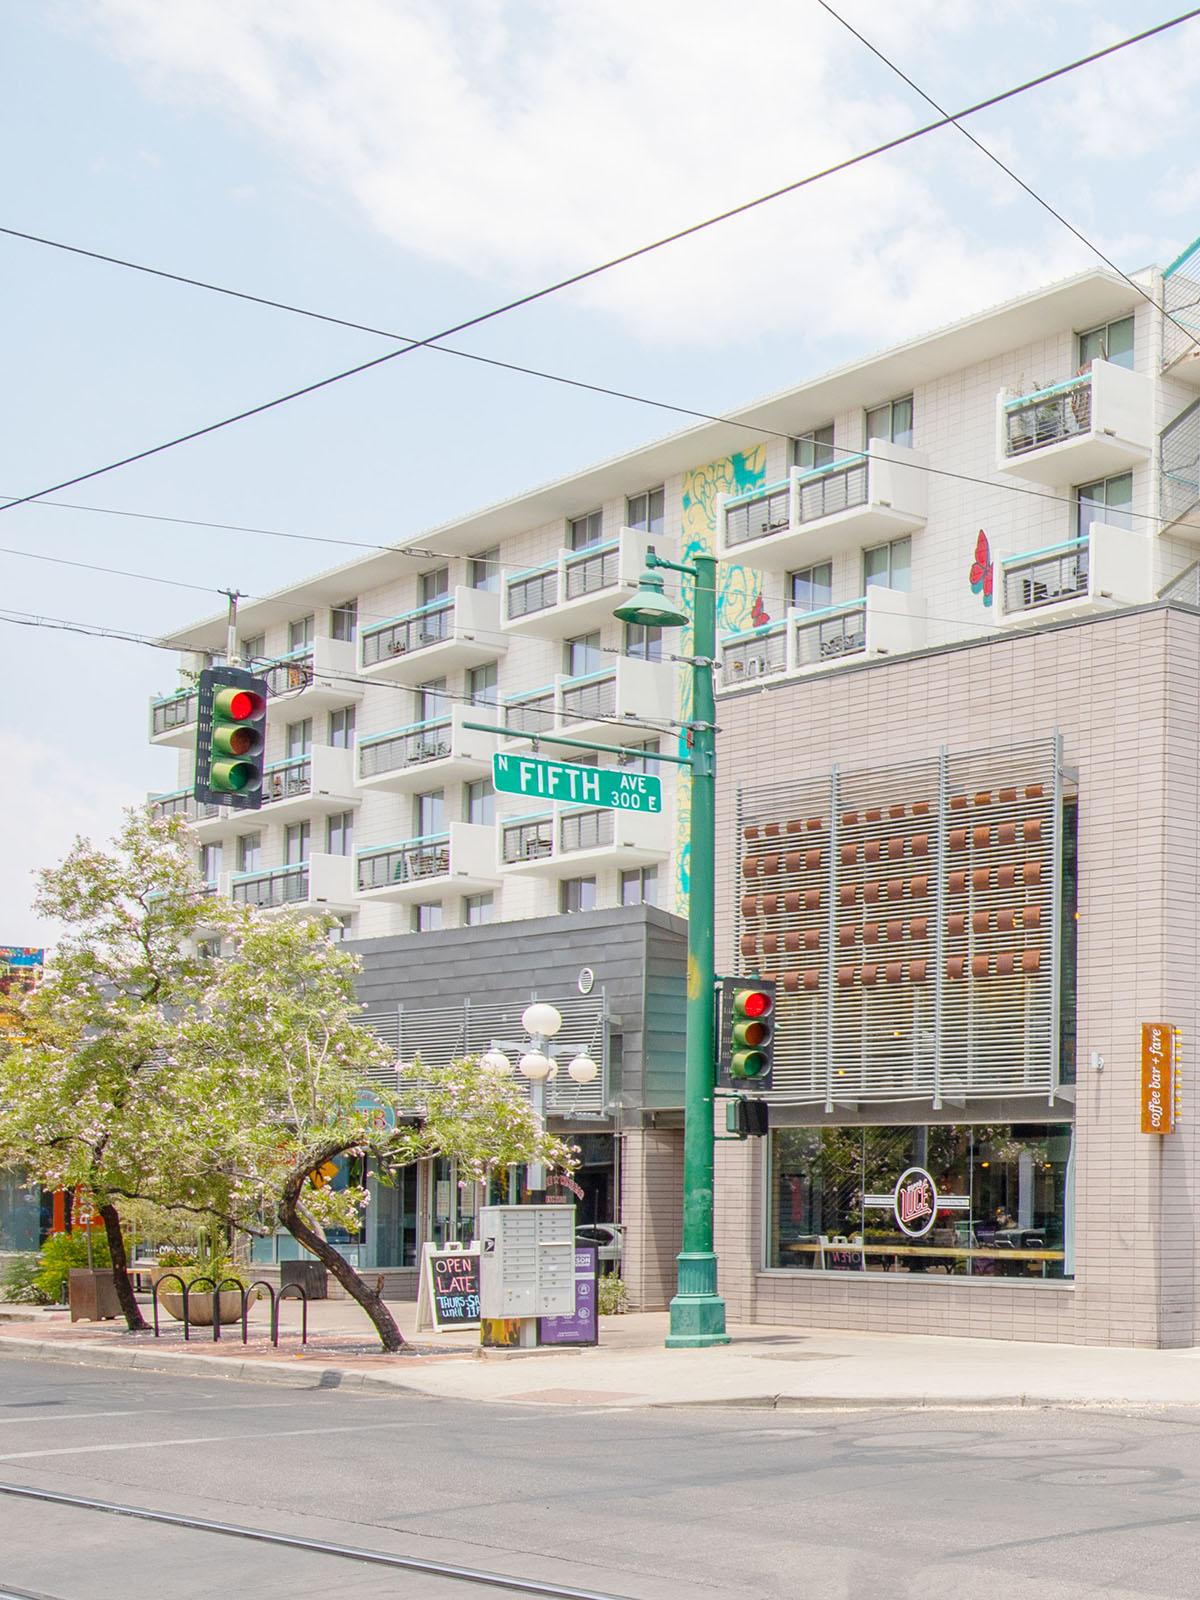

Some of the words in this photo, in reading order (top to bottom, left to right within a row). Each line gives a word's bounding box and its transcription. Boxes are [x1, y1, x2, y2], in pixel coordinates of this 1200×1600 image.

[498, 756, 509, 772] N
[519, 762, 600, 801] FIFTH
[620, 775, 647, 794] AVE
[611, 791, 640, 809] 300
[648, 796, 657, 811] E
[1148, 1028, 1164, 1057] fare
[1148, 1066, 1162, 1089] bar
[1148, 1092, 1163, 1127] coffee
[435, 1258, 472, 1273] OPEN
[437, 1276, 476, 1293] LATE
[442, 1306, 464, 1318] until
